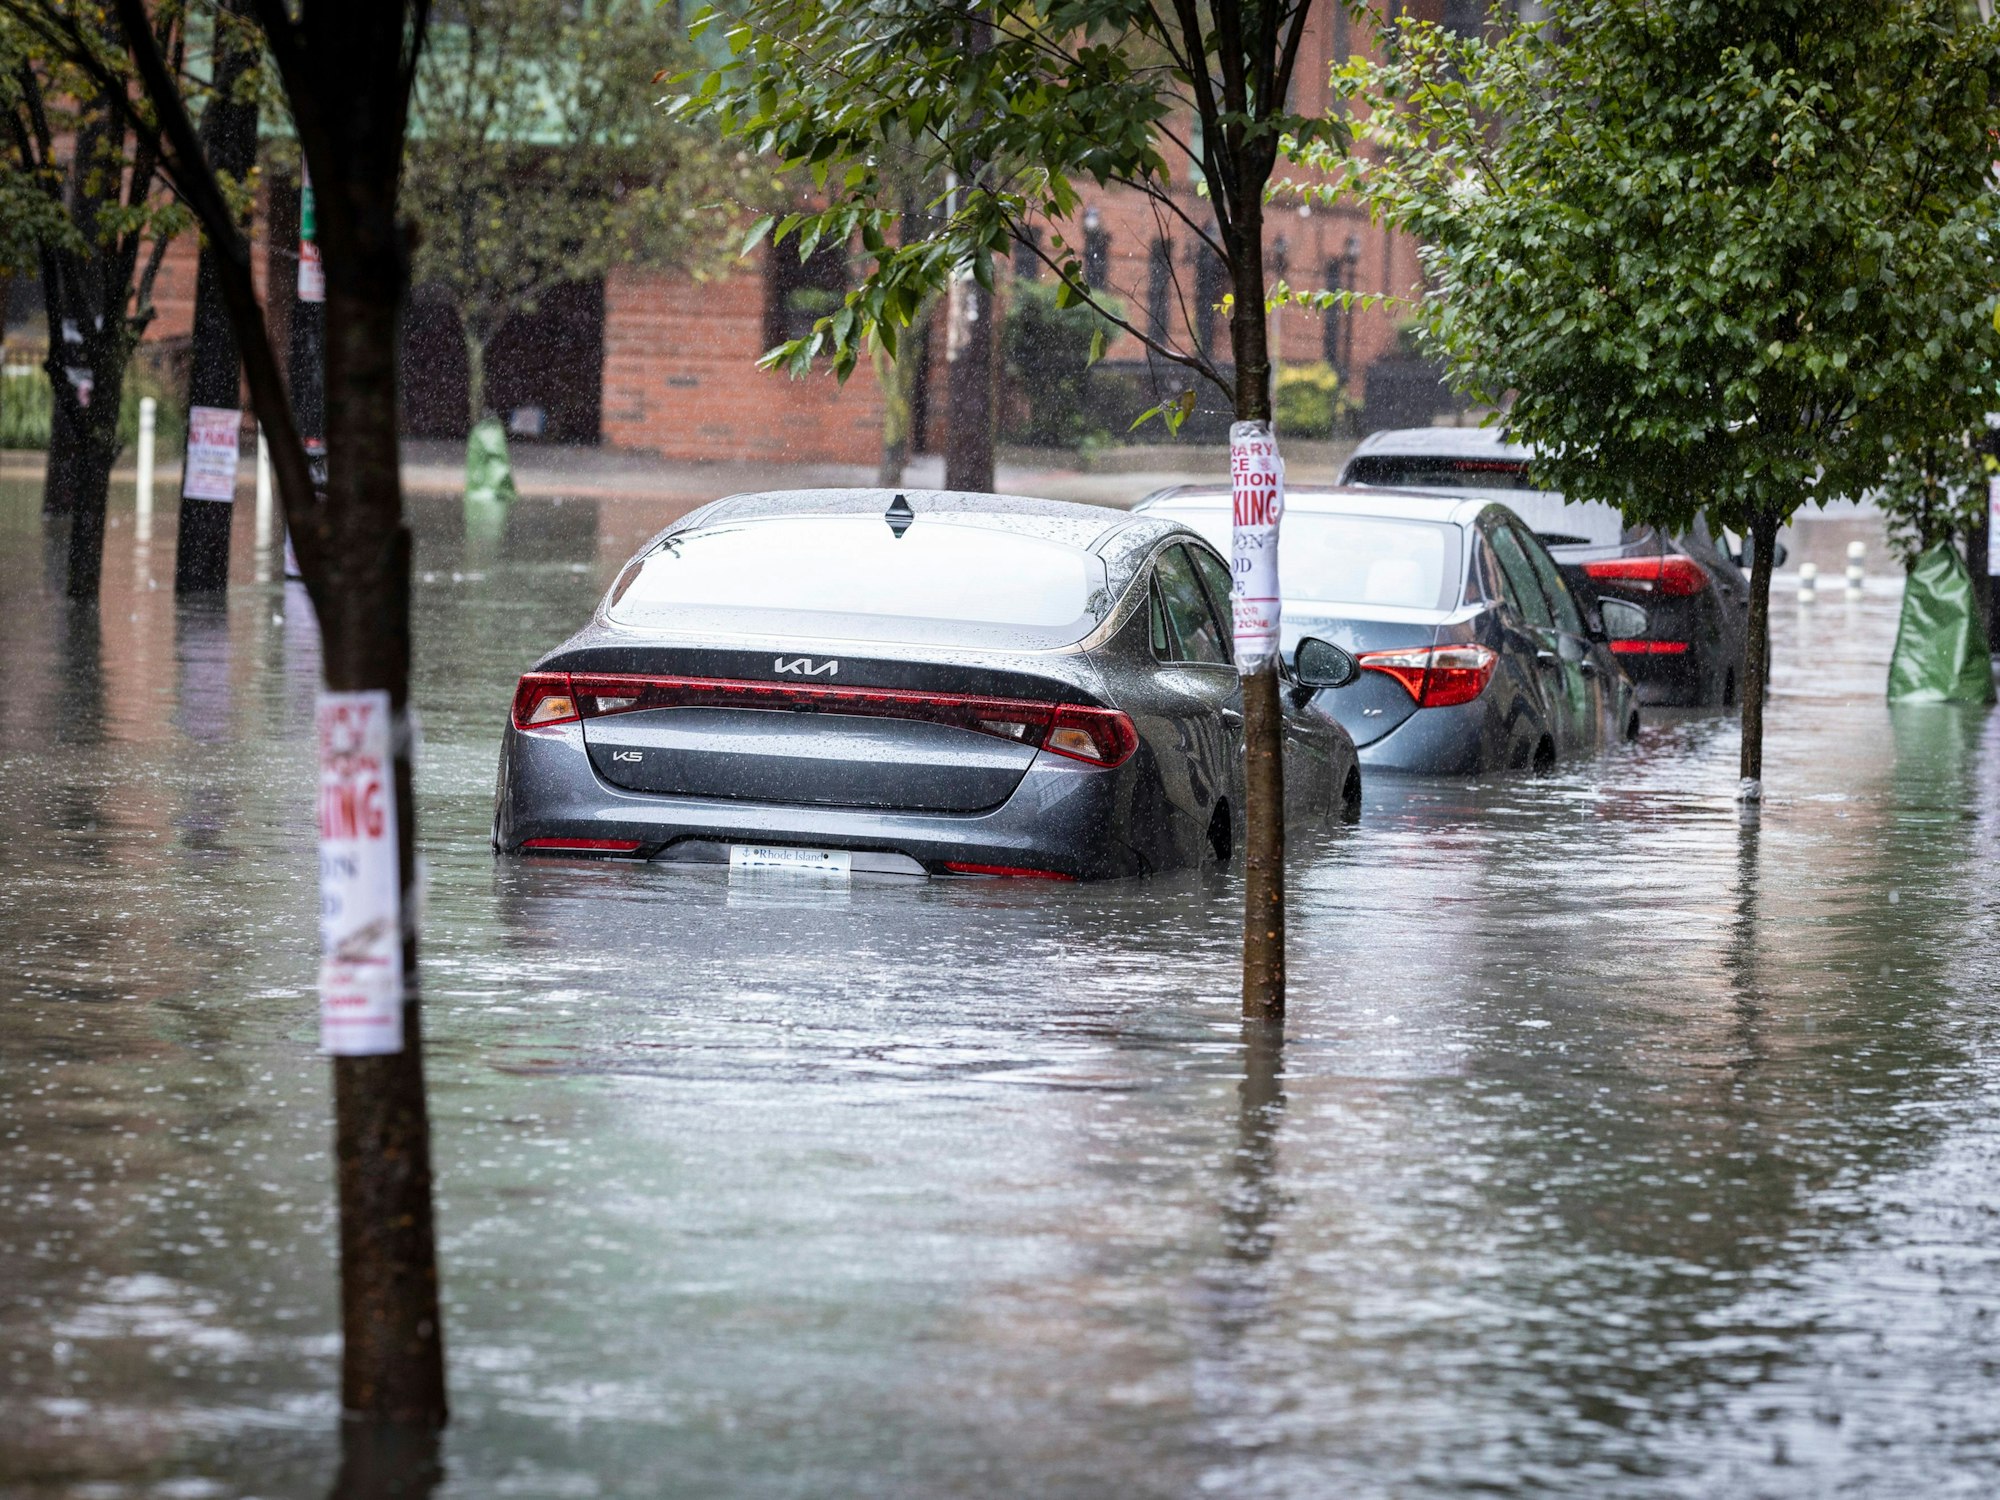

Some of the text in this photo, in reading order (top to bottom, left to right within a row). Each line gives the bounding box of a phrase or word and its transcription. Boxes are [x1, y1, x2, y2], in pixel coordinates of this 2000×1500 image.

[1233, 473, 1276, 486] TION
[1233, 490, 1276, 526] KING
[613, 751, 643, 762] K5
[759, 849, 824, 862] Rhode Island
